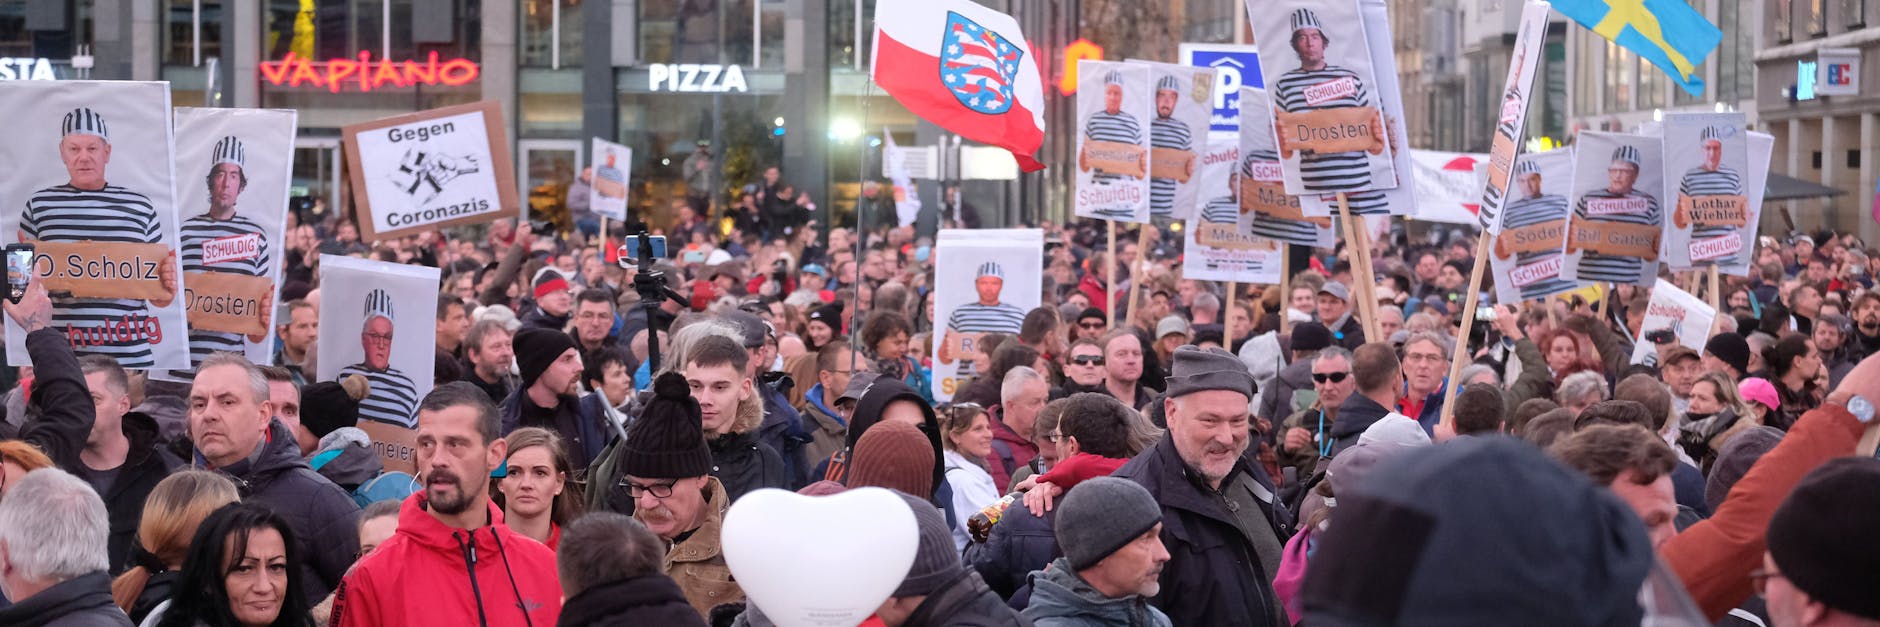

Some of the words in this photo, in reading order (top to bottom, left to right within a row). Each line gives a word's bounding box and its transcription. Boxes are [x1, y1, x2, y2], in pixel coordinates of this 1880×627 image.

[260, 50, 478, 93] VAPIANO
[649, 63, 747, 92] PIZZA
[1307, 80, 1352, 101] SCHULDIG
[388, 121, 455, 143] Gegen
[1297, 124, 1369, 142] Drosten
[1203, 146, 1239, 166] chuld
[1079, 184, 1140, 206] Schuldig
[1258, 187, 1300, 209] Maa
[1590, 200, 1645, 212] SCHULDIG
[1692, 198, 1737, 209] Lothar
[386, 196, 489, 227] Coronazis
[1689, 208, 1741, 221] Wiehler
[205, 238, 255, 260] SCHULDIG
[1607, 231, 1652, 247] Gates
[1692, 237, 1740, 258] SCHULDIG
[34, 253, 160, 280] O.Scholz
[184, 287, 257, 317] Drosten
[67, 313, 162, 350] huldig
[373, 441, 415, 463] meier
